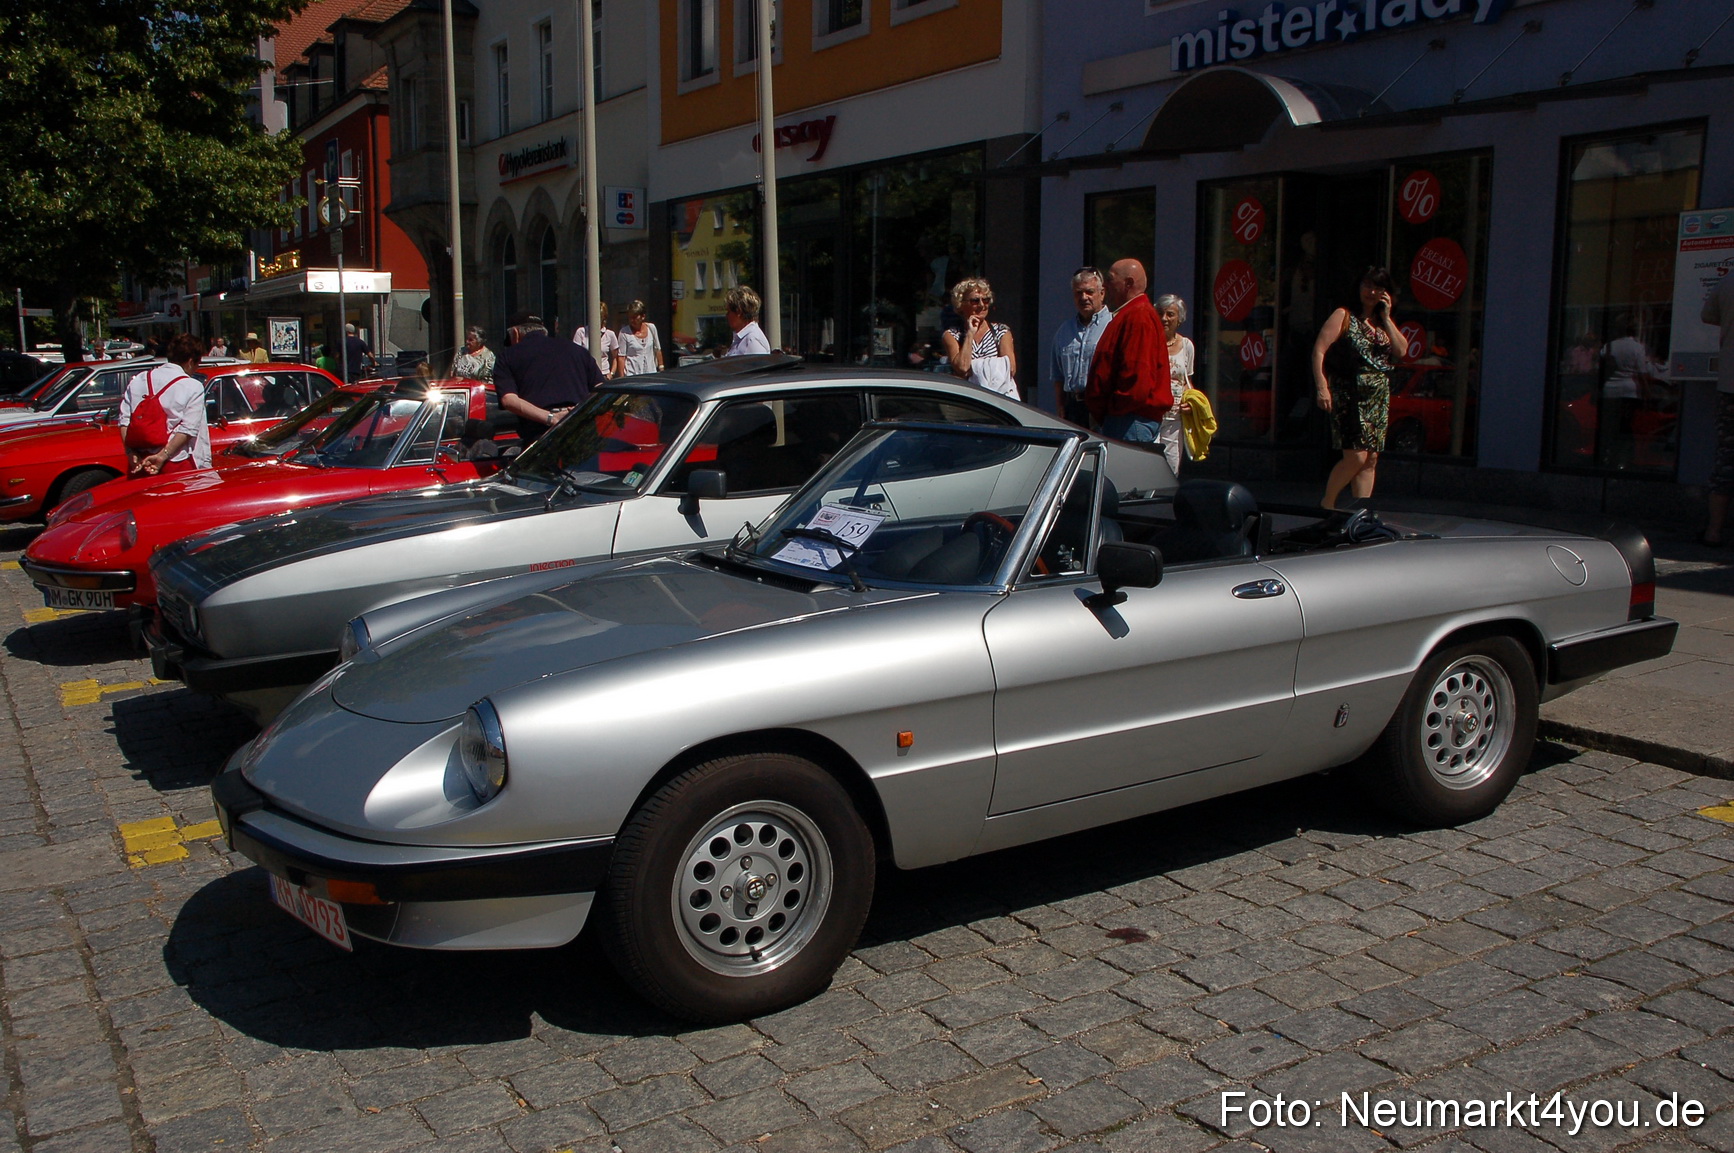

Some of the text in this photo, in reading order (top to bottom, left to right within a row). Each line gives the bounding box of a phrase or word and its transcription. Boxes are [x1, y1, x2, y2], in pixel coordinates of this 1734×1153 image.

[1171, 0, 1501, 70] mister lady
[1402, 177, 1434, 218] %
[1235, 202, 1260, 241] %
[1421, 247, 1455, 271] FREAKY
[1215, 270, 1239, 300] FREAKY
[1219, 271, 1254, 315] SALE!
[1413, 260, 1461, 295] SALE!
[1241, 337, 1264, 367] %
[835, 520, 870, 540] 159
[67, 590, 84, 607] GK
[86, 591, 112, 607] 90H
